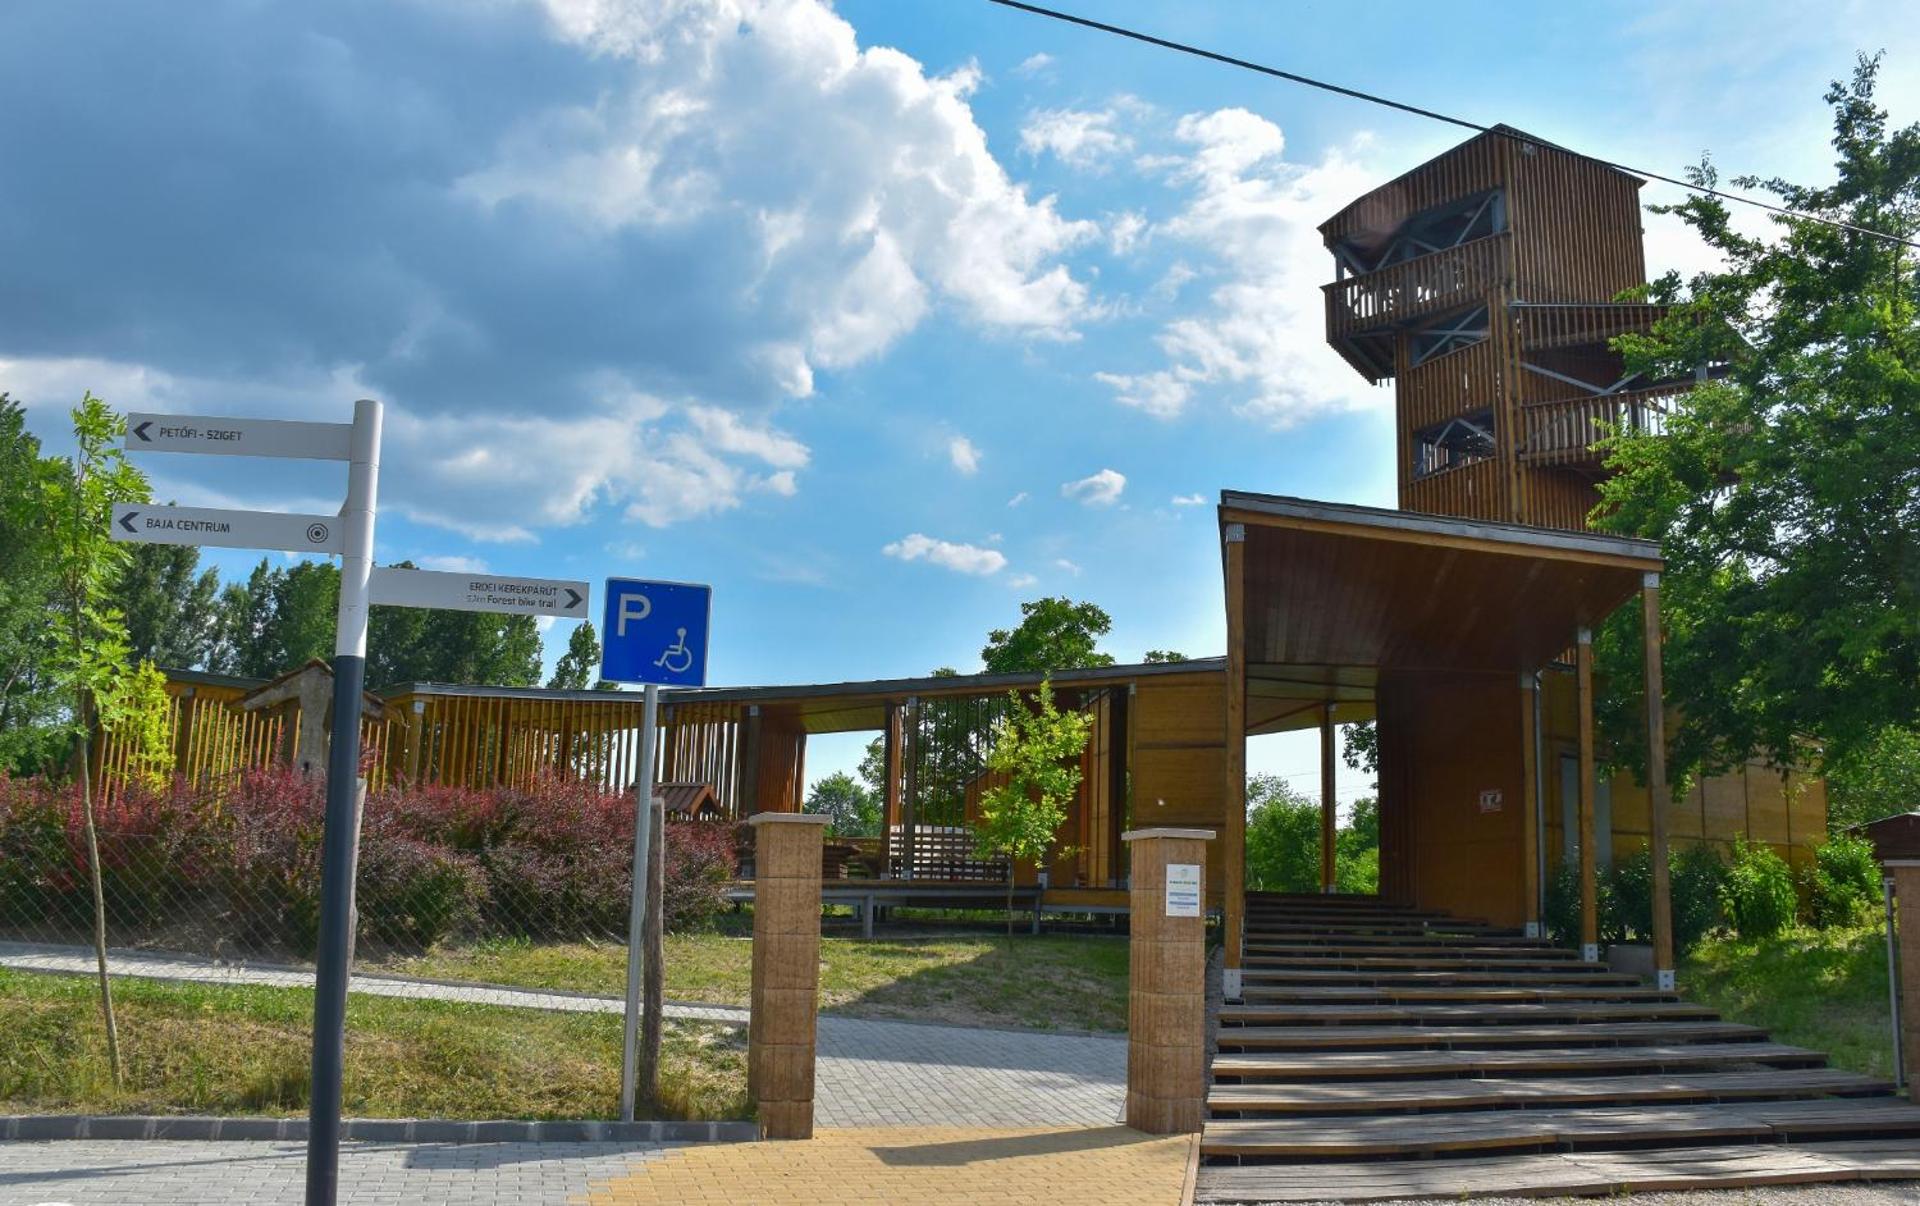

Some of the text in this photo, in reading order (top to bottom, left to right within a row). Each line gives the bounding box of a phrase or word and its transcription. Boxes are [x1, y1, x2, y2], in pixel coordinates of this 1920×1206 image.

[206, 429, 242, 441] SZIGET
[146, 518, 231, 533] BAJA CENTRUM
[469, 582, 496, 593] ERDEI
[486, 594, 516, 605] Forest
[517, 596, 536, 607] bike
[538, 598, 556, 609] trail
[617, 593, 651, 637] P
